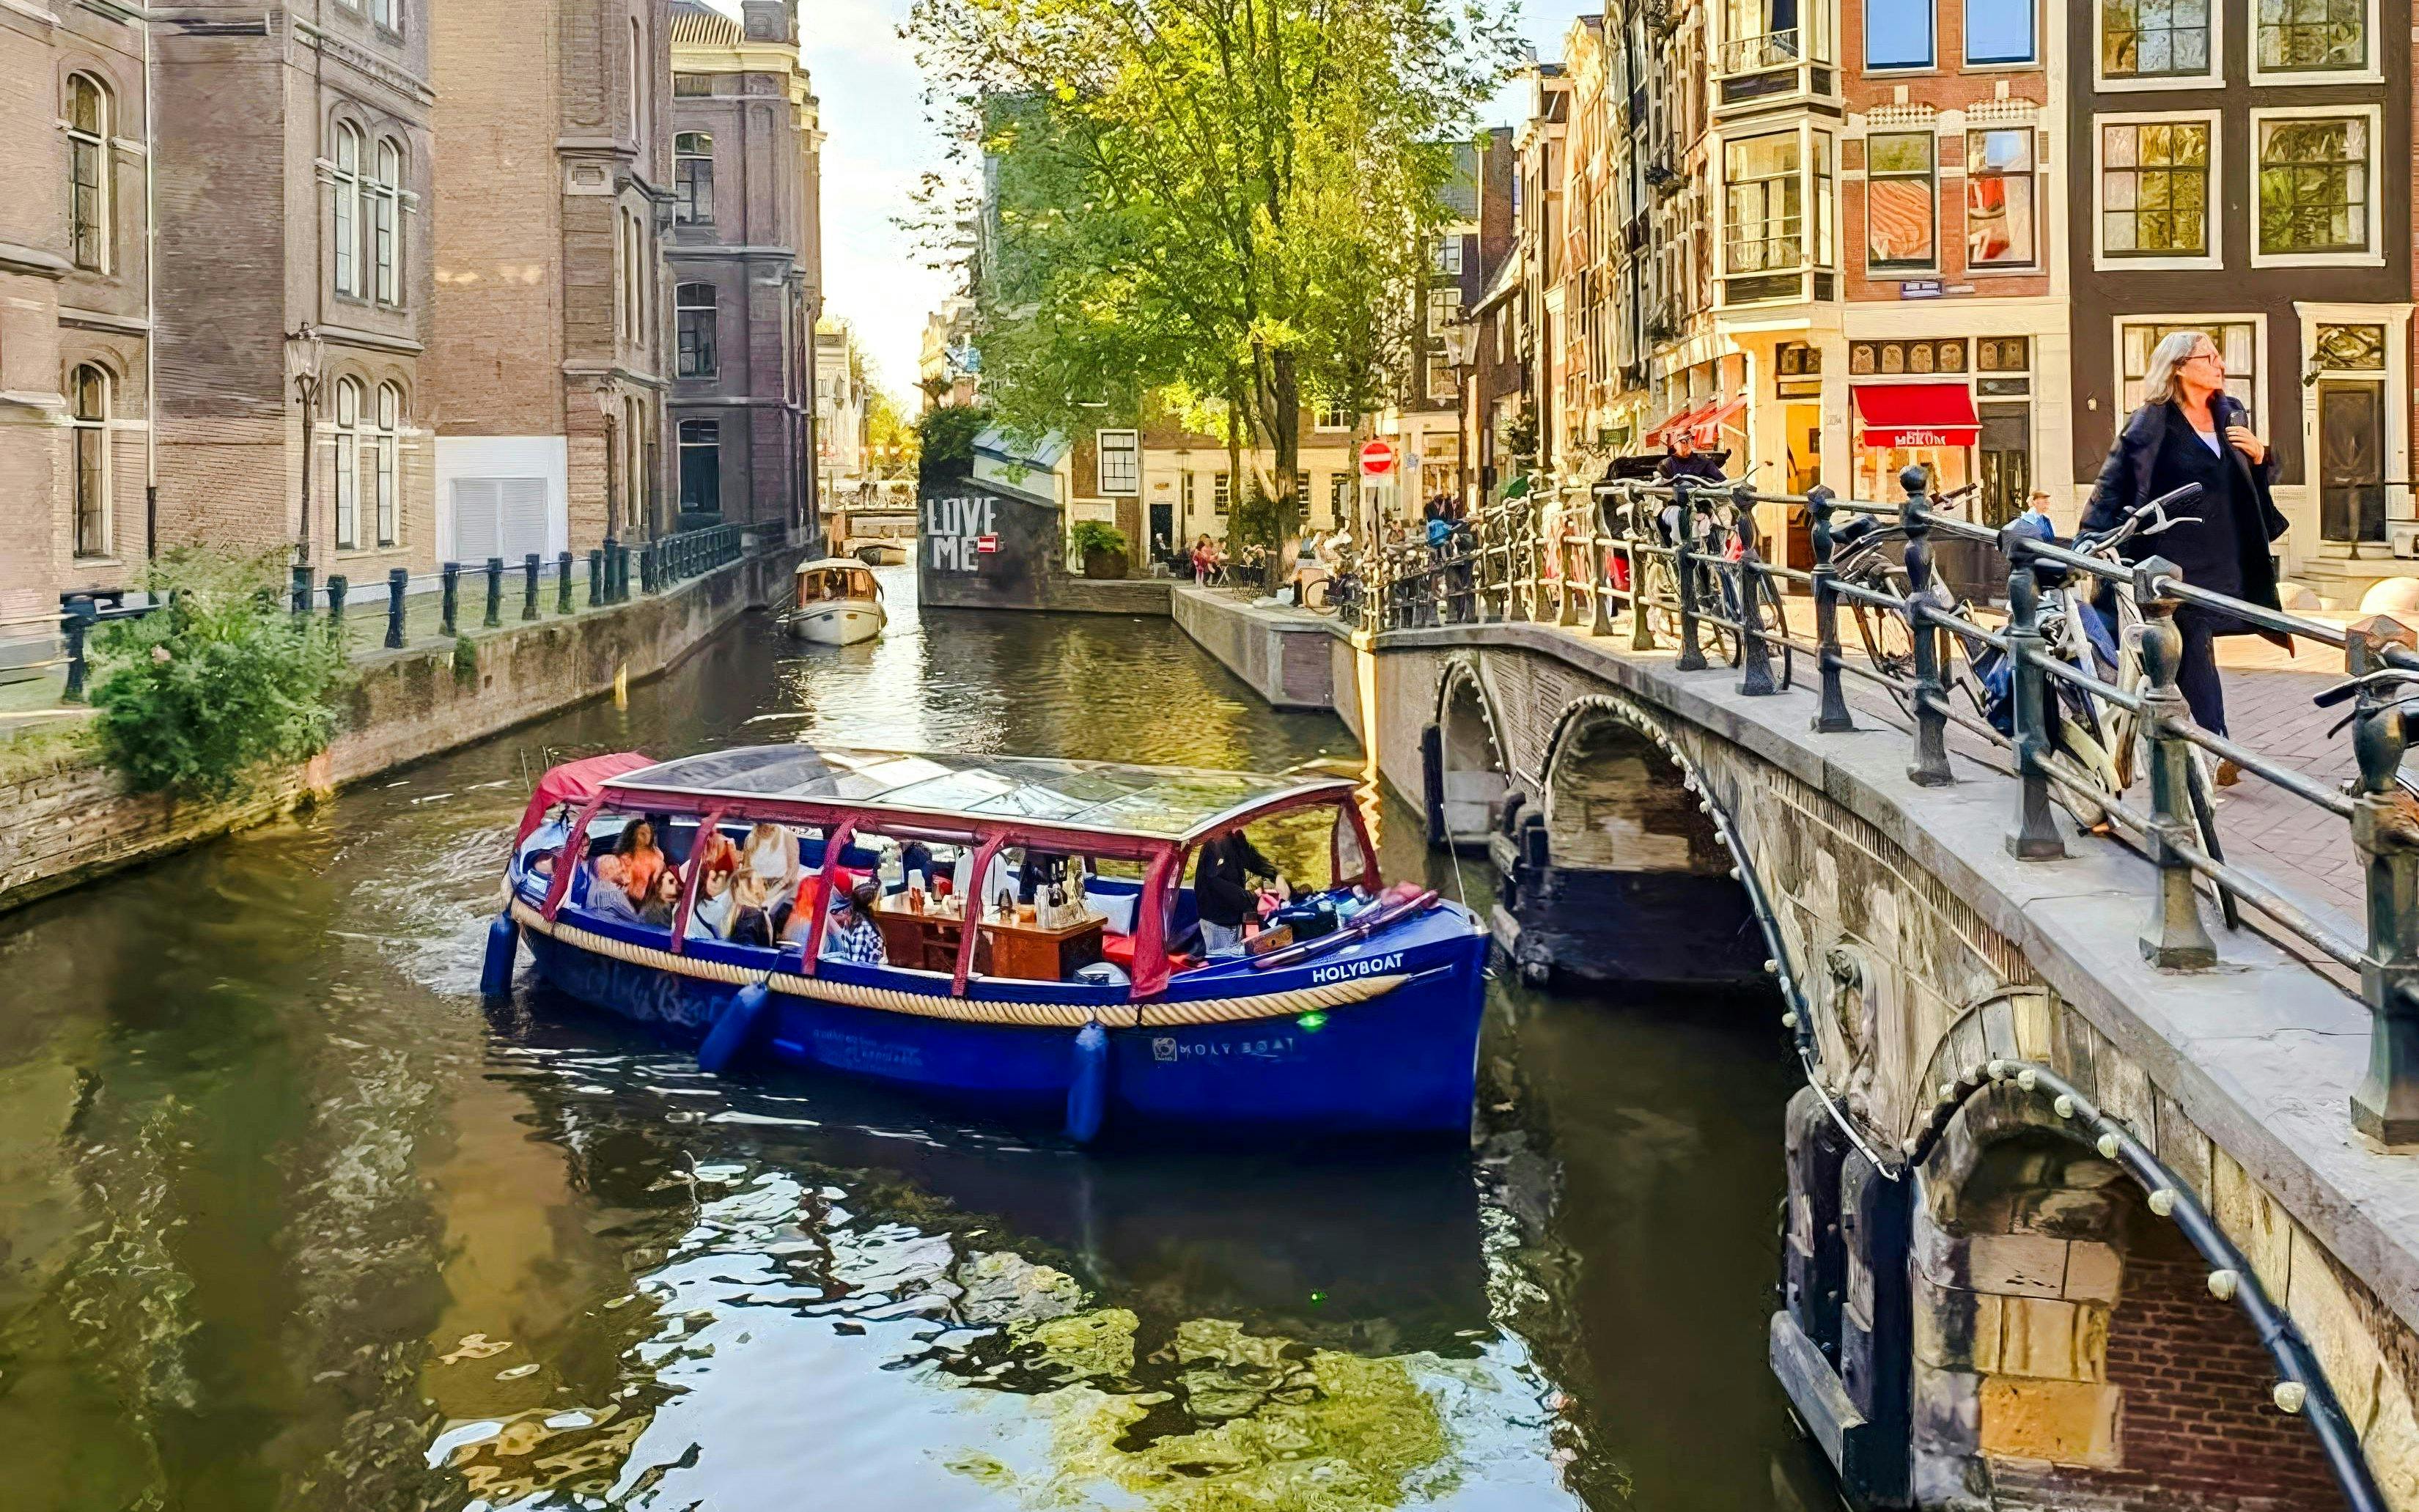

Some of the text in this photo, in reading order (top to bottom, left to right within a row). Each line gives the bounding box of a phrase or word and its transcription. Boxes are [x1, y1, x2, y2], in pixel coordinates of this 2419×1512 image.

[927, 496, 1000, 536] LOVE
[933, 536, 979, 572] ME
[1313, 953, 1404, 983] HOLYBOAT
